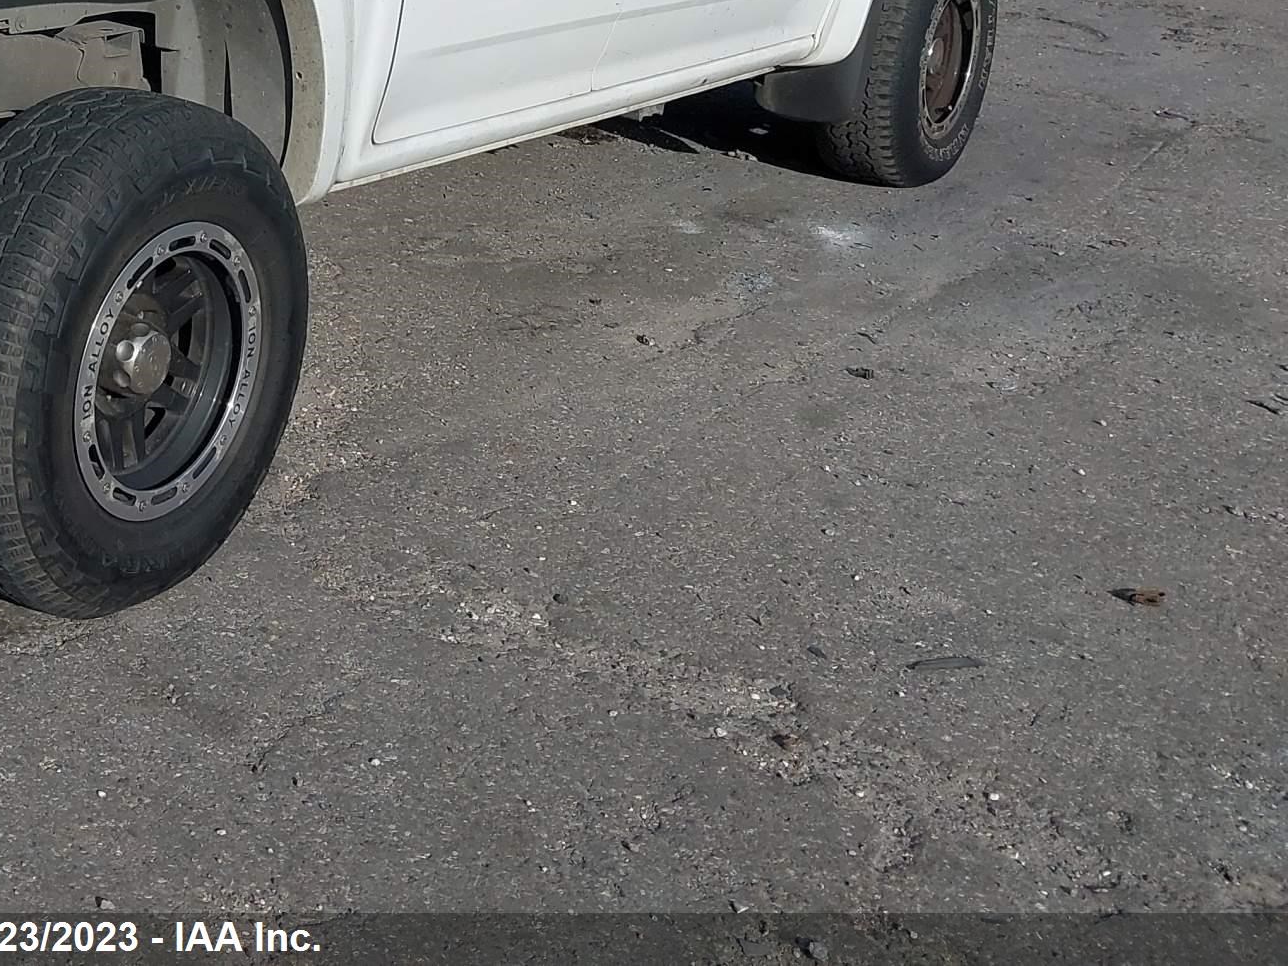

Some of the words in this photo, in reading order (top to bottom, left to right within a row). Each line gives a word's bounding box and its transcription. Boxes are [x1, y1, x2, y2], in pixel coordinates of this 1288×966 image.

[82, 384, 94, 421] ION
[88, 308, 114, 374] ALLOY
[247, 325, 256, 358] ION
[229, 369, 251, 427] ALLOY
